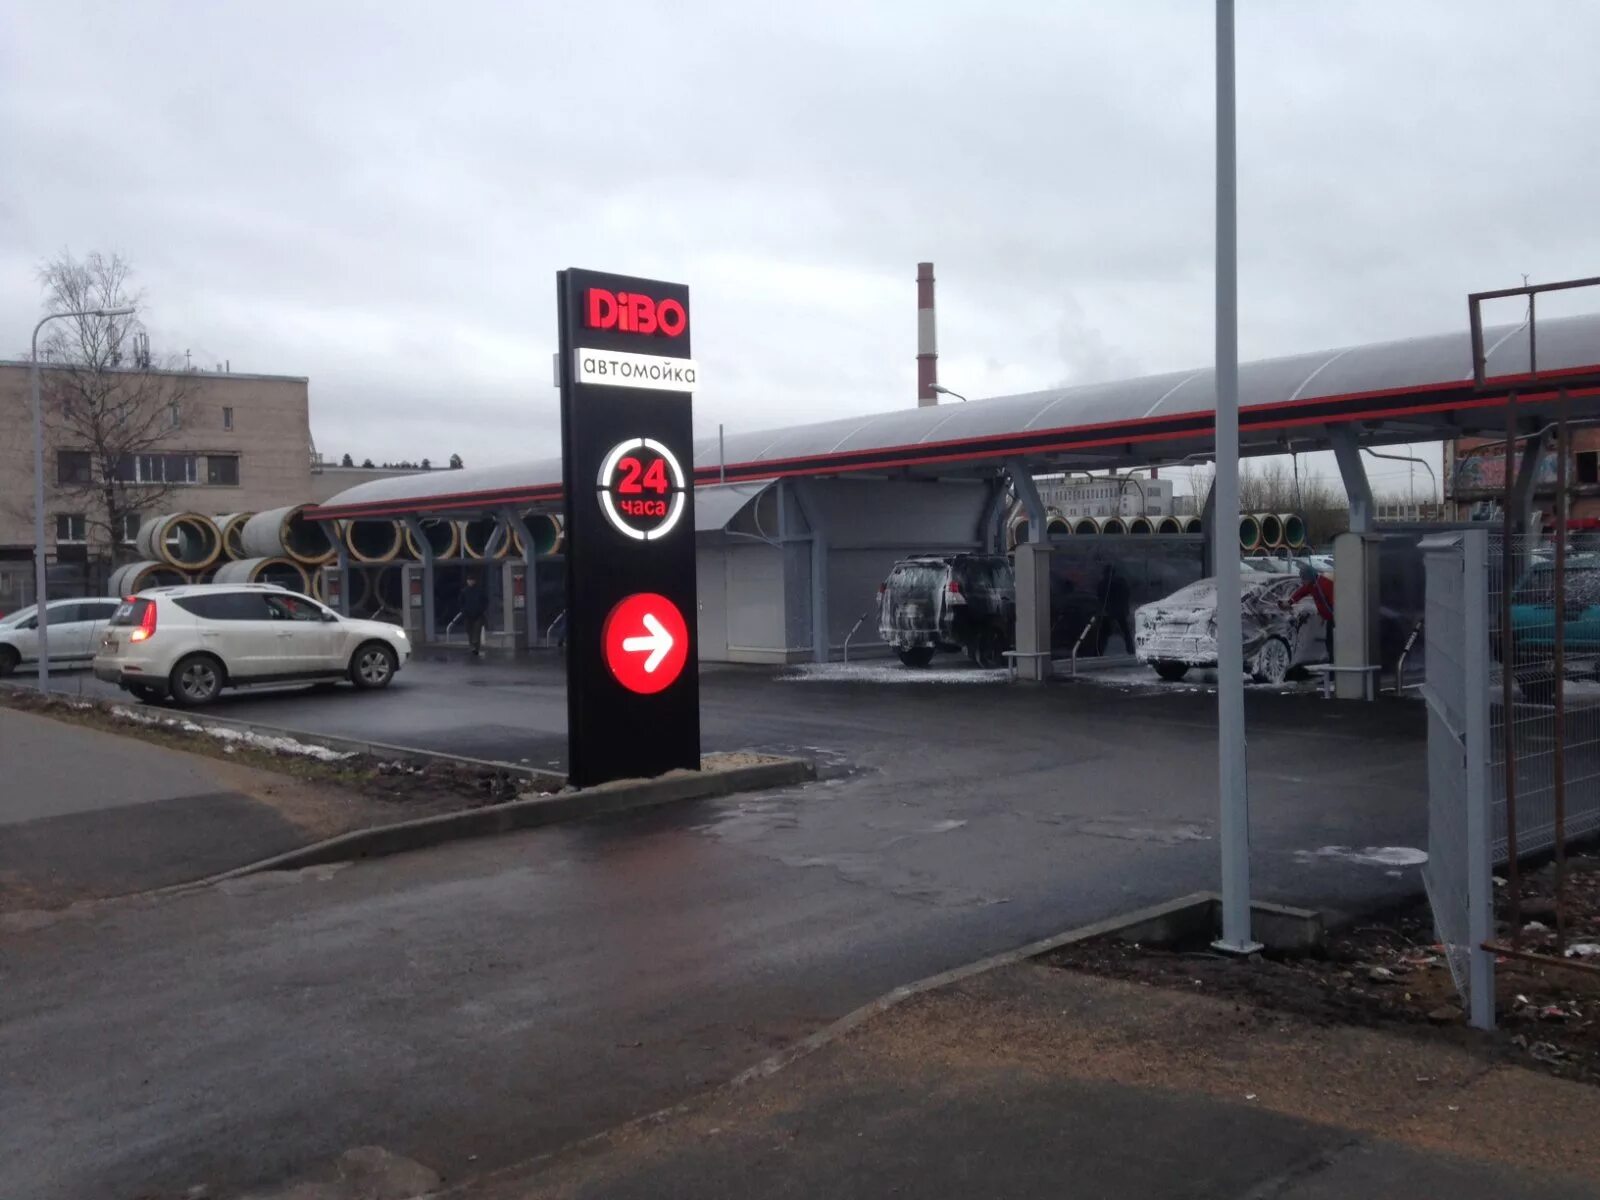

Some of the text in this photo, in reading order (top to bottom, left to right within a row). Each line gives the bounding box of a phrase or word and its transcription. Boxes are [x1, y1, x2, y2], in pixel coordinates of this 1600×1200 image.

[586, 287, 687, 337] DiBO
[583, 357, 696, 384] автомойка
[618, 457, 668, 494] 24
[620, 499, 666, 516] часа
